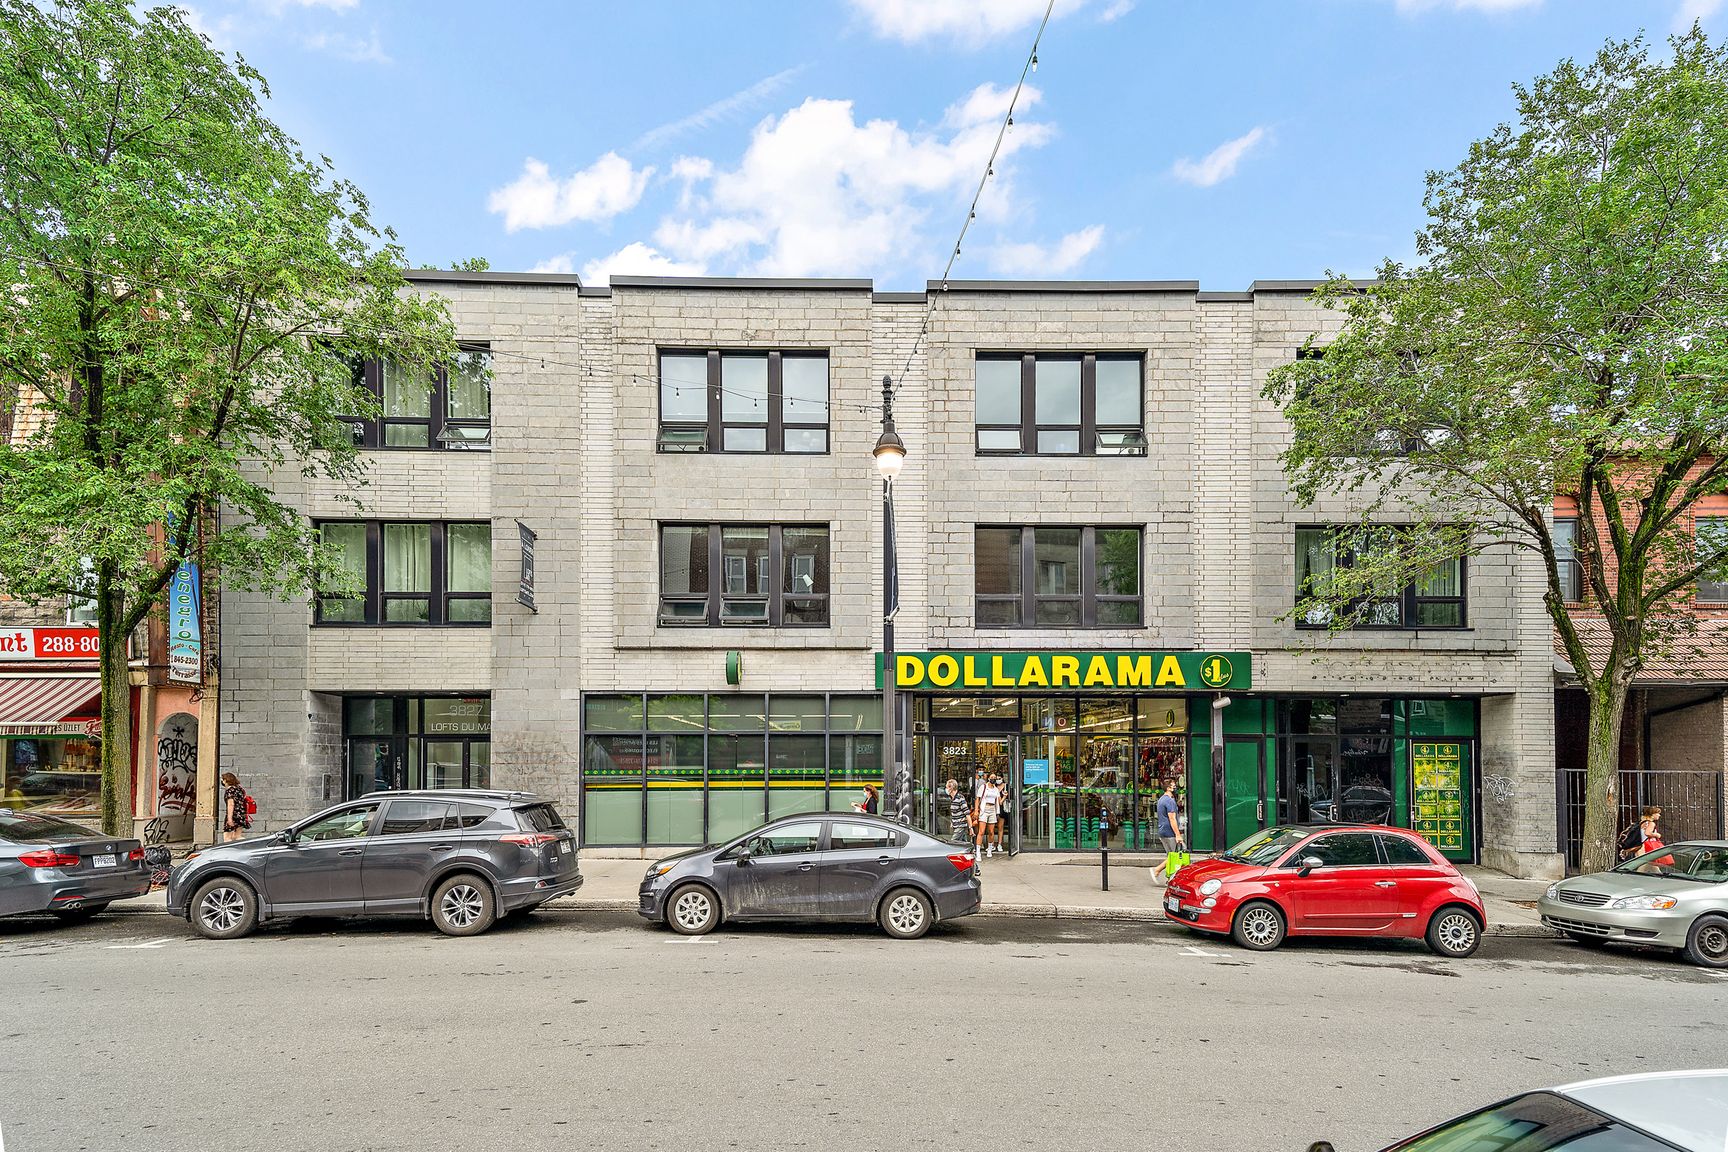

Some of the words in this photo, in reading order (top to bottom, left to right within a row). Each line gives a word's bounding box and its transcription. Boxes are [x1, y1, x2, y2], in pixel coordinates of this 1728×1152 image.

[42, 636, 100, 653] 288-80
[896, 654, 1187, 687] DOLLARAMA
[449, 704, 483, 717] 3827
[431, 722, 459, 731] LOFTS
[461, 722, 475, 731] DU
[943, 746, 967, 755] 3823
